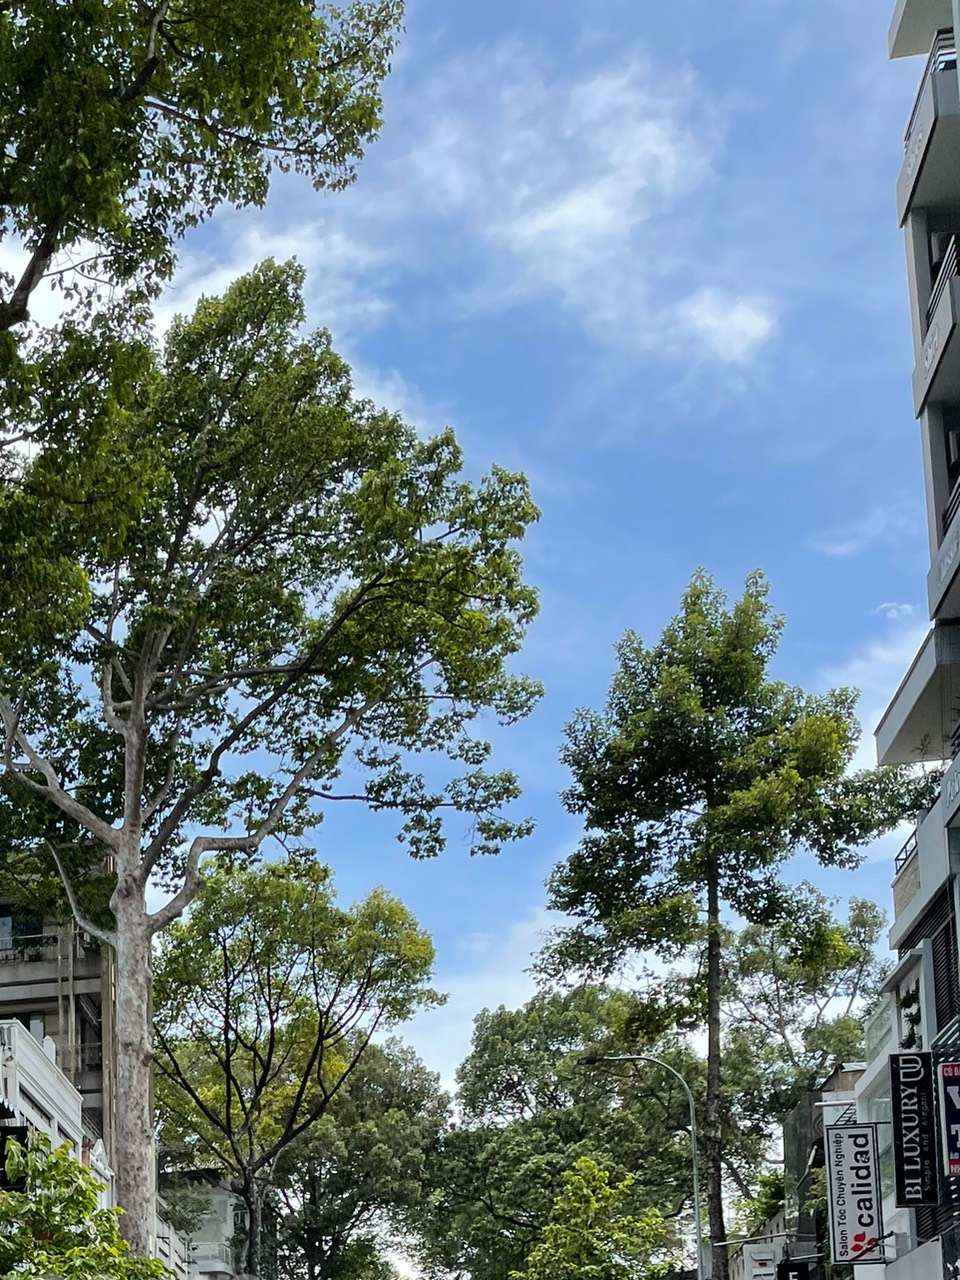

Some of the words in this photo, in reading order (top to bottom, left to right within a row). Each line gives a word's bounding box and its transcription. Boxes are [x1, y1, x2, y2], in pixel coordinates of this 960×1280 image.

[900, 1085, 922, 1172] LUXURY
[833, 1132, 845, 1167] Nghiệp
[834, 1170, 847, 1206] Chuyên
[848, 1133, 874, 1227] calidad
[905, 1176, 923, 1200] BI
[837, 1209, 847, 1227] Tóc
[839, 1230, 849, 1257] Salon
